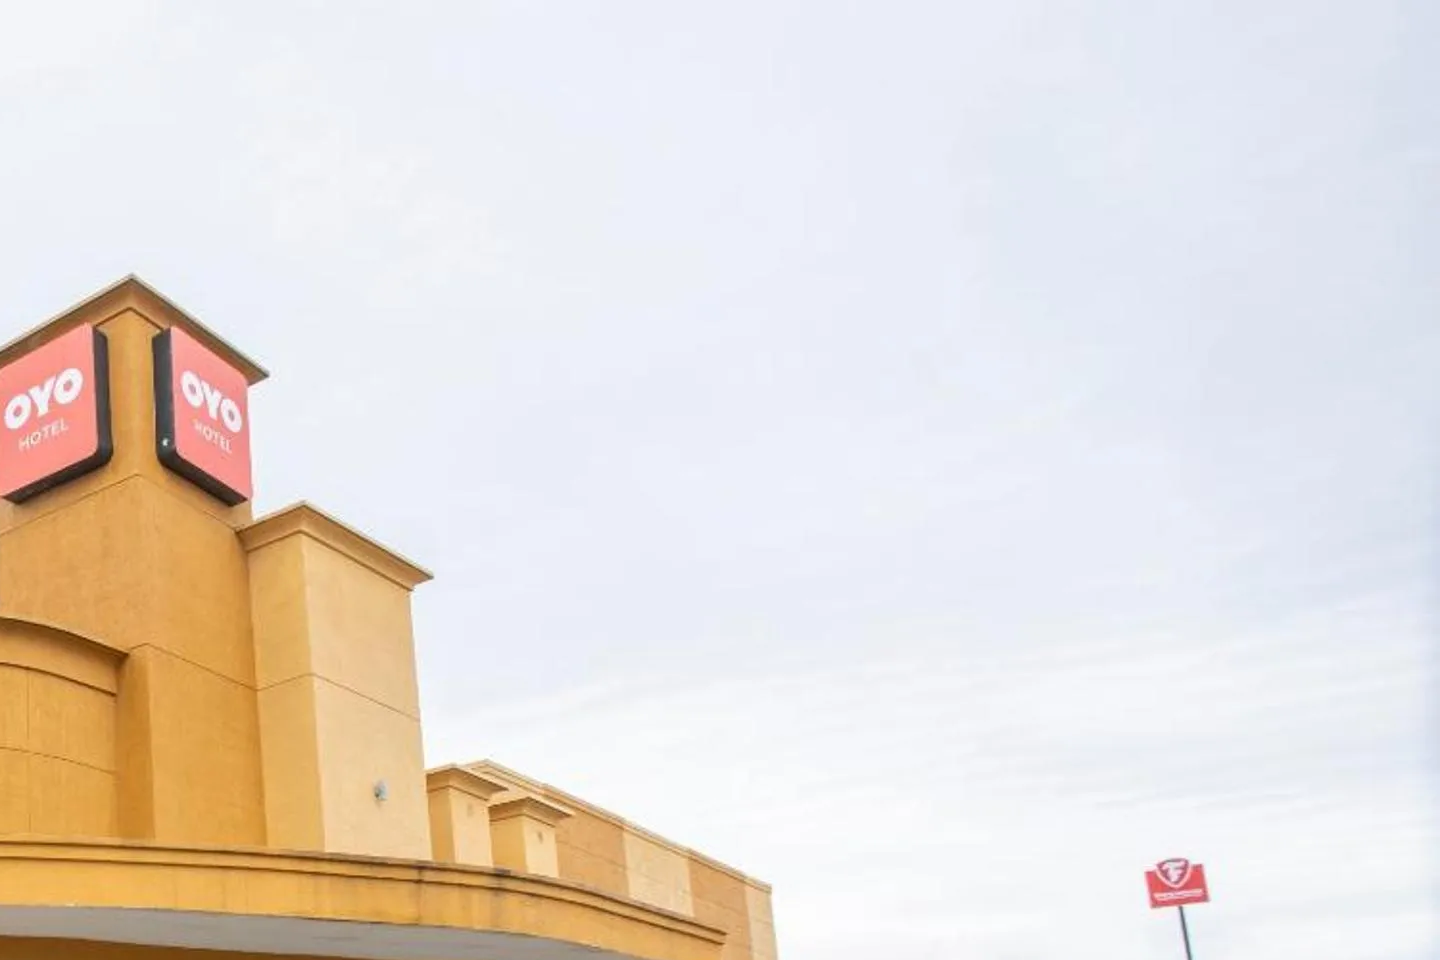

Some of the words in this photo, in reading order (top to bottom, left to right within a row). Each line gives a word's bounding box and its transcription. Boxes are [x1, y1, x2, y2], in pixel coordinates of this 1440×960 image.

[4, 367, 83, 429] OYO
[181, 370, 242, 433] OYO
[18, 417, 69, 452] HOTEL
[193, 418, 233, 454] HOTEL
